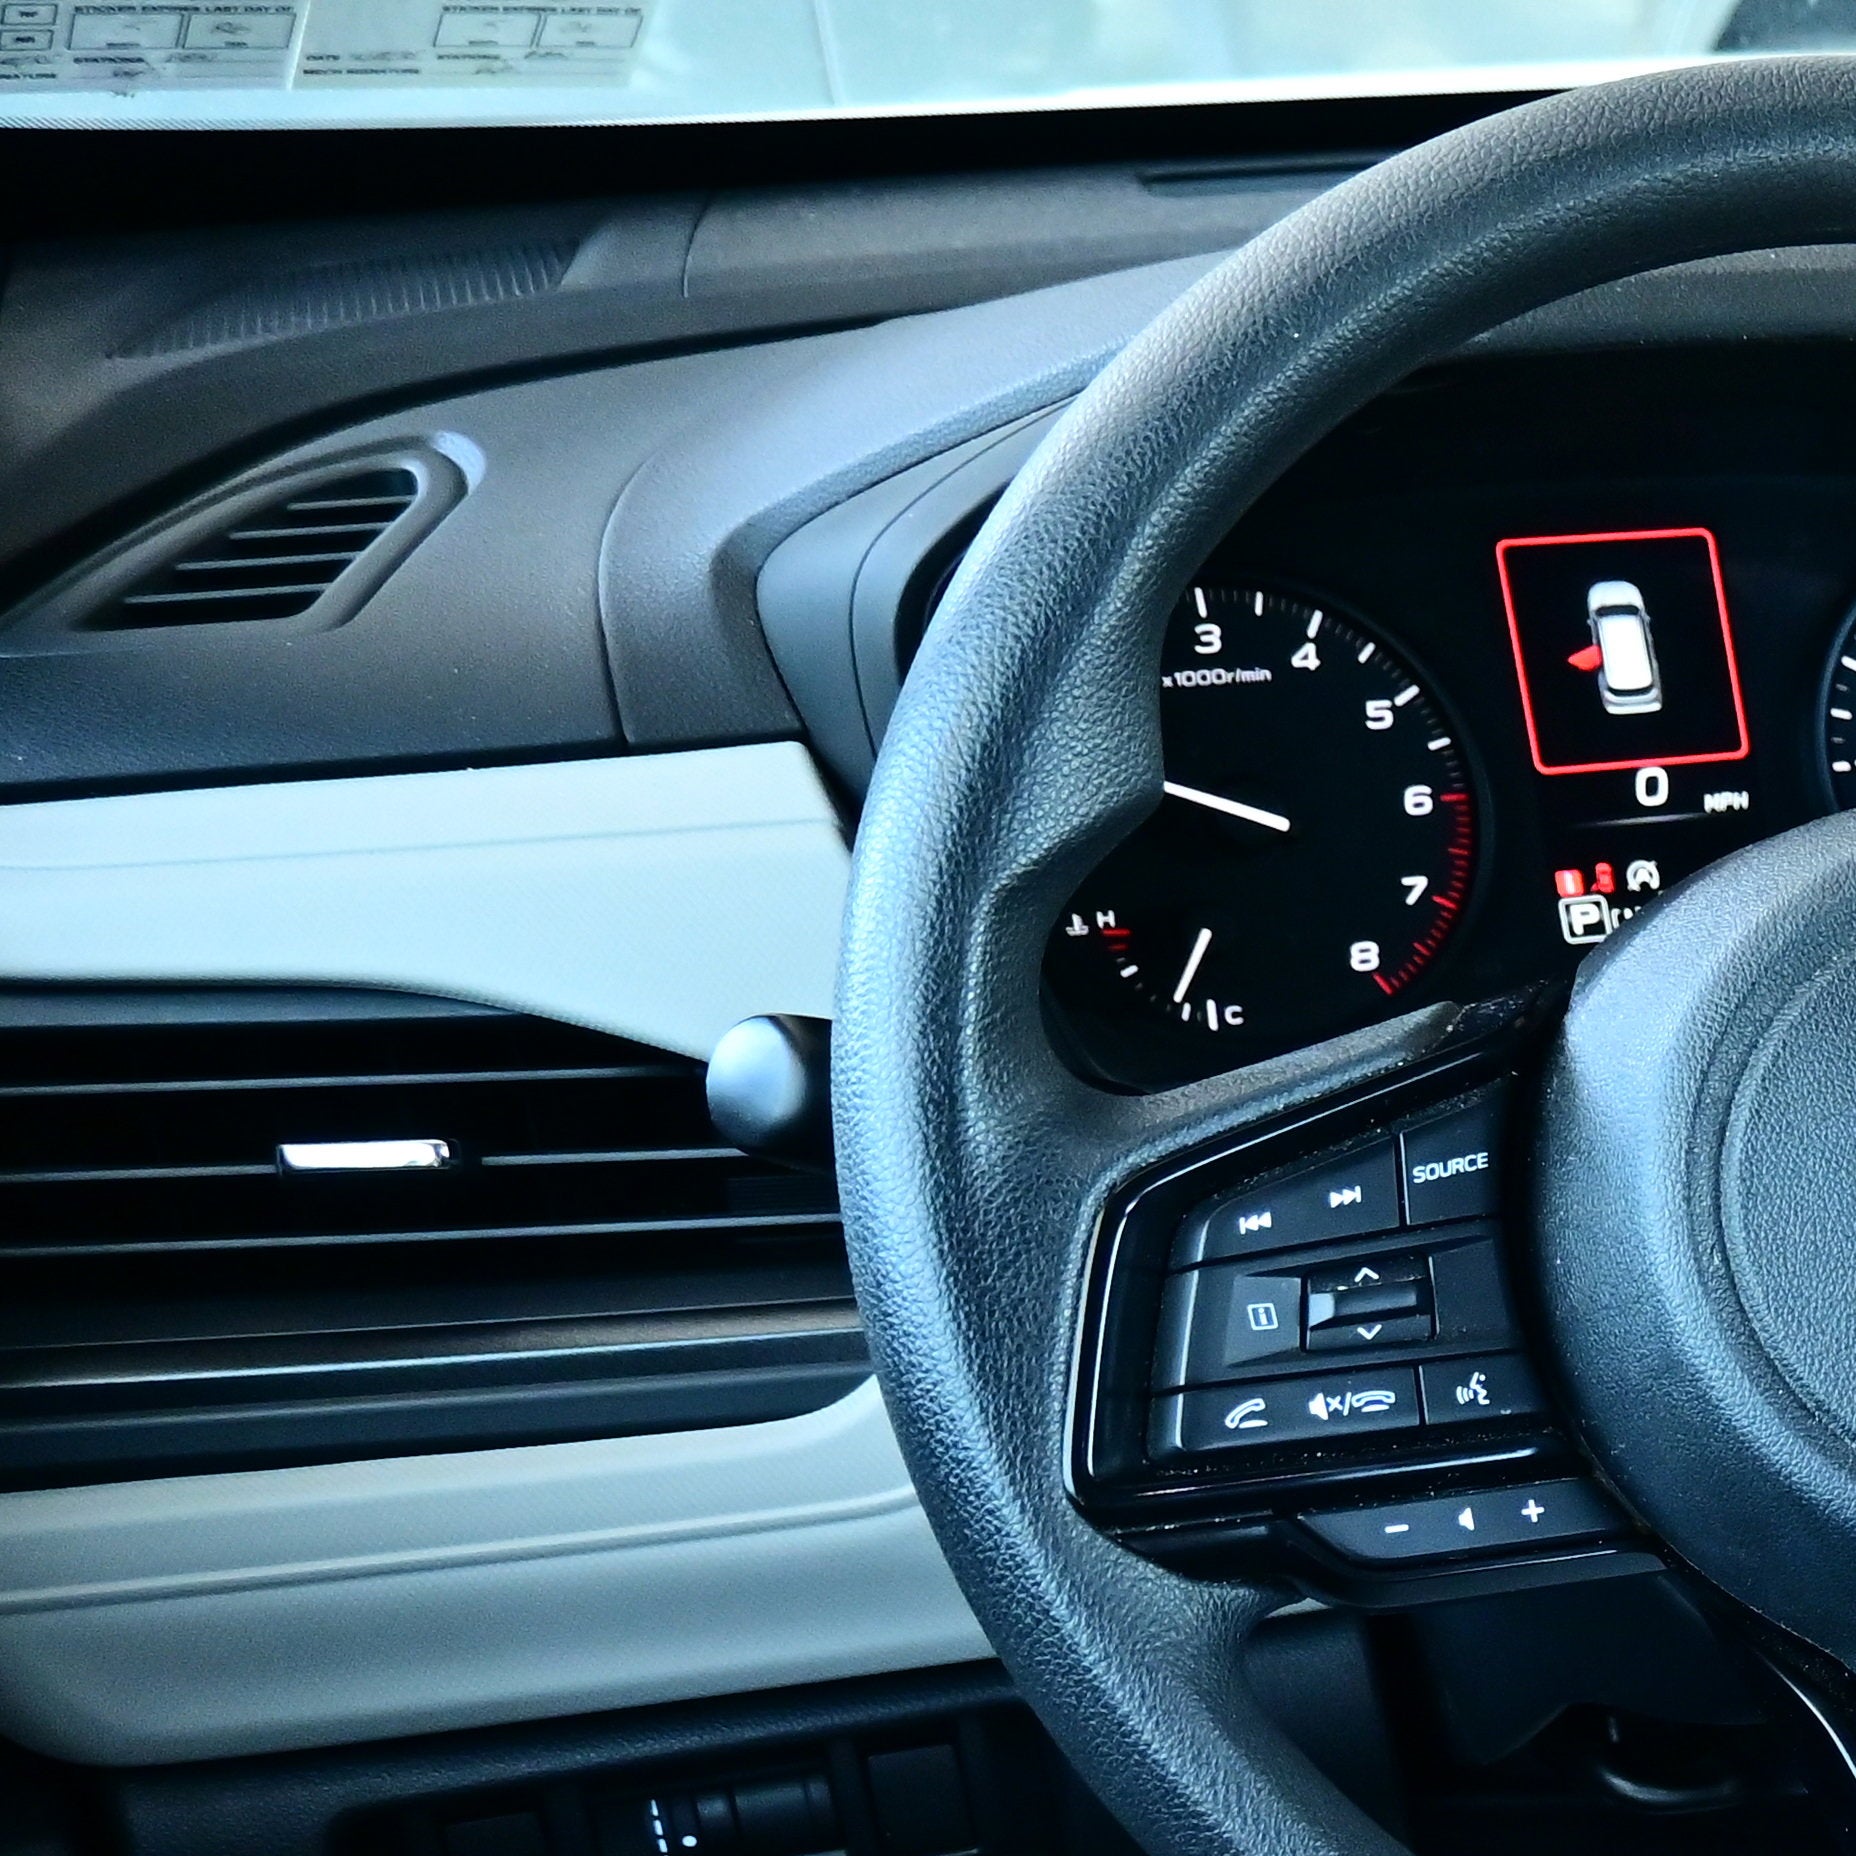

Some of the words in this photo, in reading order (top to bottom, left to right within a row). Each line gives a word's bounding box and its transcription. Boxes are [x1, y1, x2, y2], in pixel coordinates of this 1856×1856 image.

[1194, 624, 1222, 654] 3
[1291, 642, 1321, 671] 4
[1365, 699, 1394, 730] 5
[1403, 785, 1433, 815] 6
[1635, 766, 1668, 806] 0
[1704, 790, 1750, 813] MPH
[1401, 876, 1428, 904] 7
[1096, 911, 1115, 930] H
[1569, 903, 1601, 935] P
[1349, 941, 1380, 971] 8
[1225, 1004, 1244, 1026] C
[1412, 1152, 1489, 1184] SOURCE
